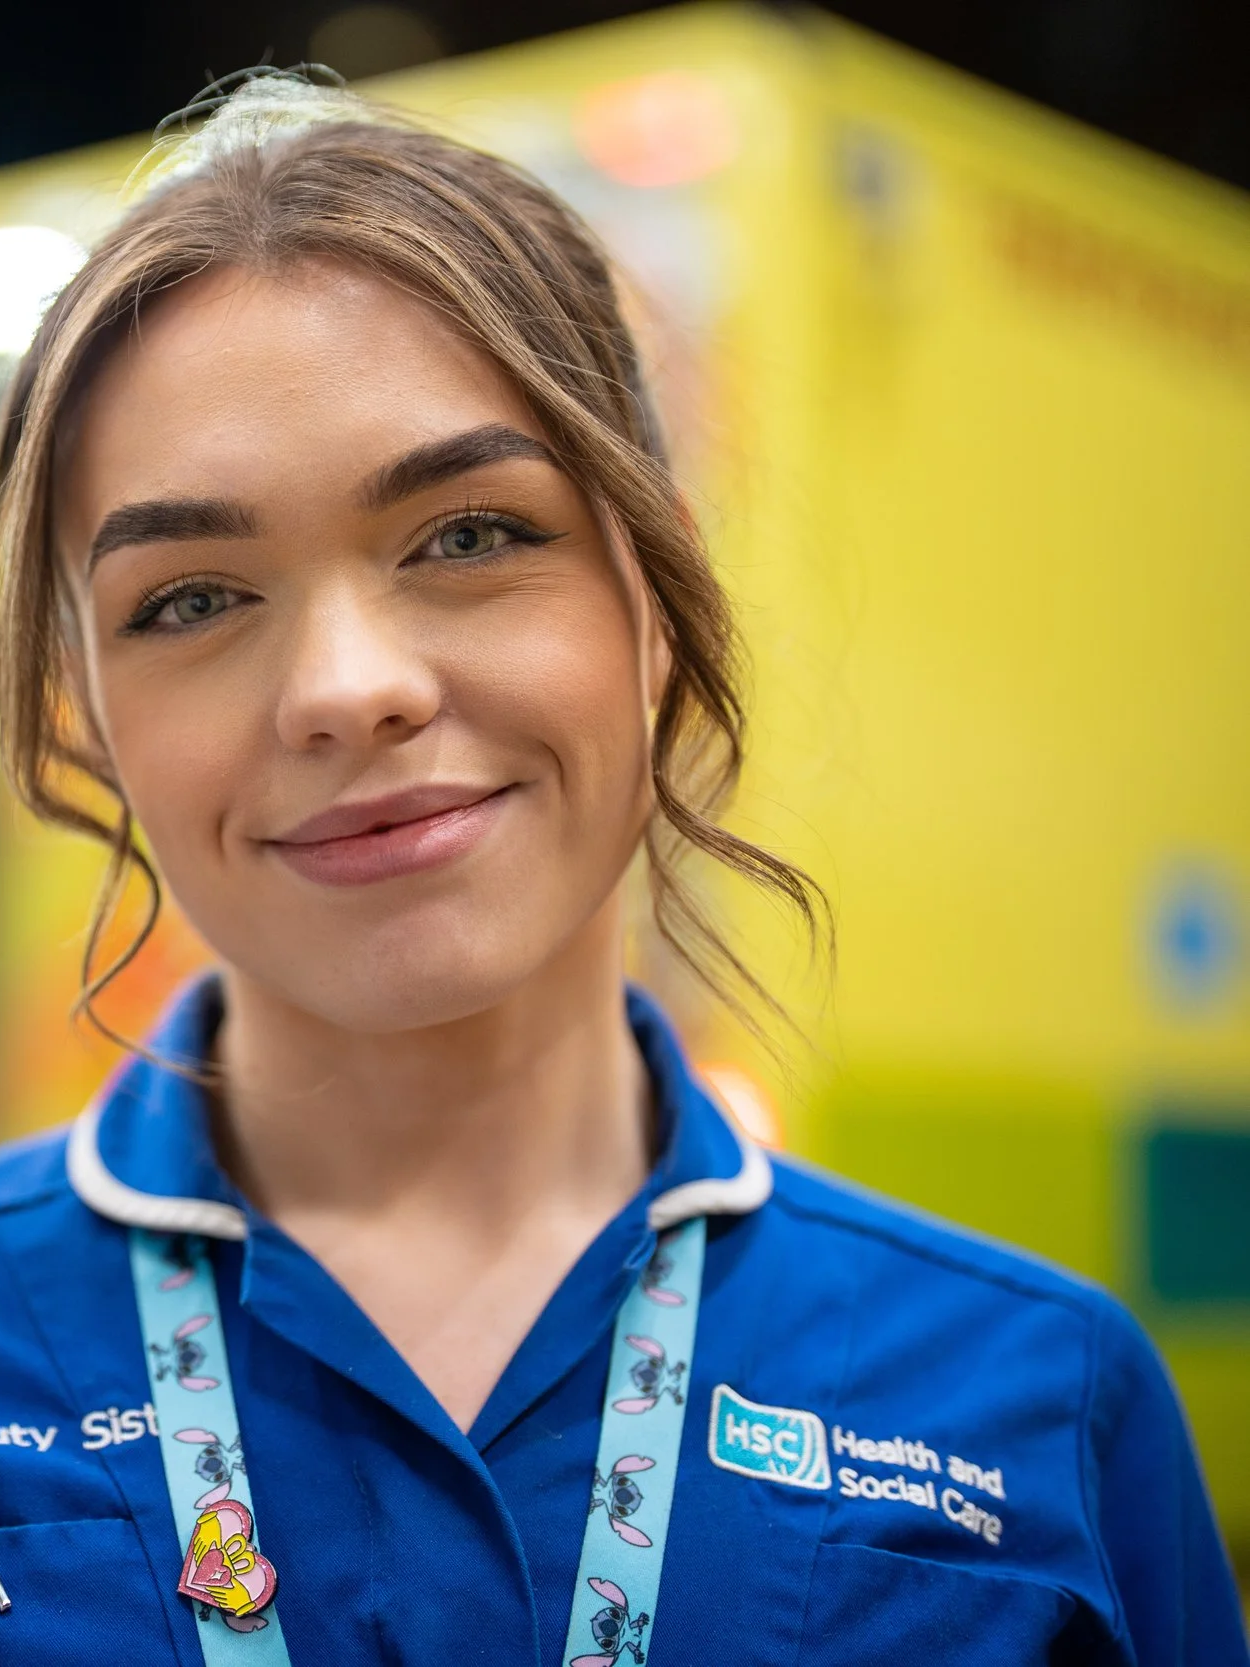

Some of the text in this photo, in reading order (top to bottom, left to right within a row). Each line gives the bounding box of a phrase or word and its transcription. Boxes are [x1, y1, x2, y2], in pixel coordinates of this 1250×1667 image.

[725, 1413, 798, 1462] HSC
[832, 1424, 1007, 1500] Health and
[837, 1466, 1002, 1546] Social Care
